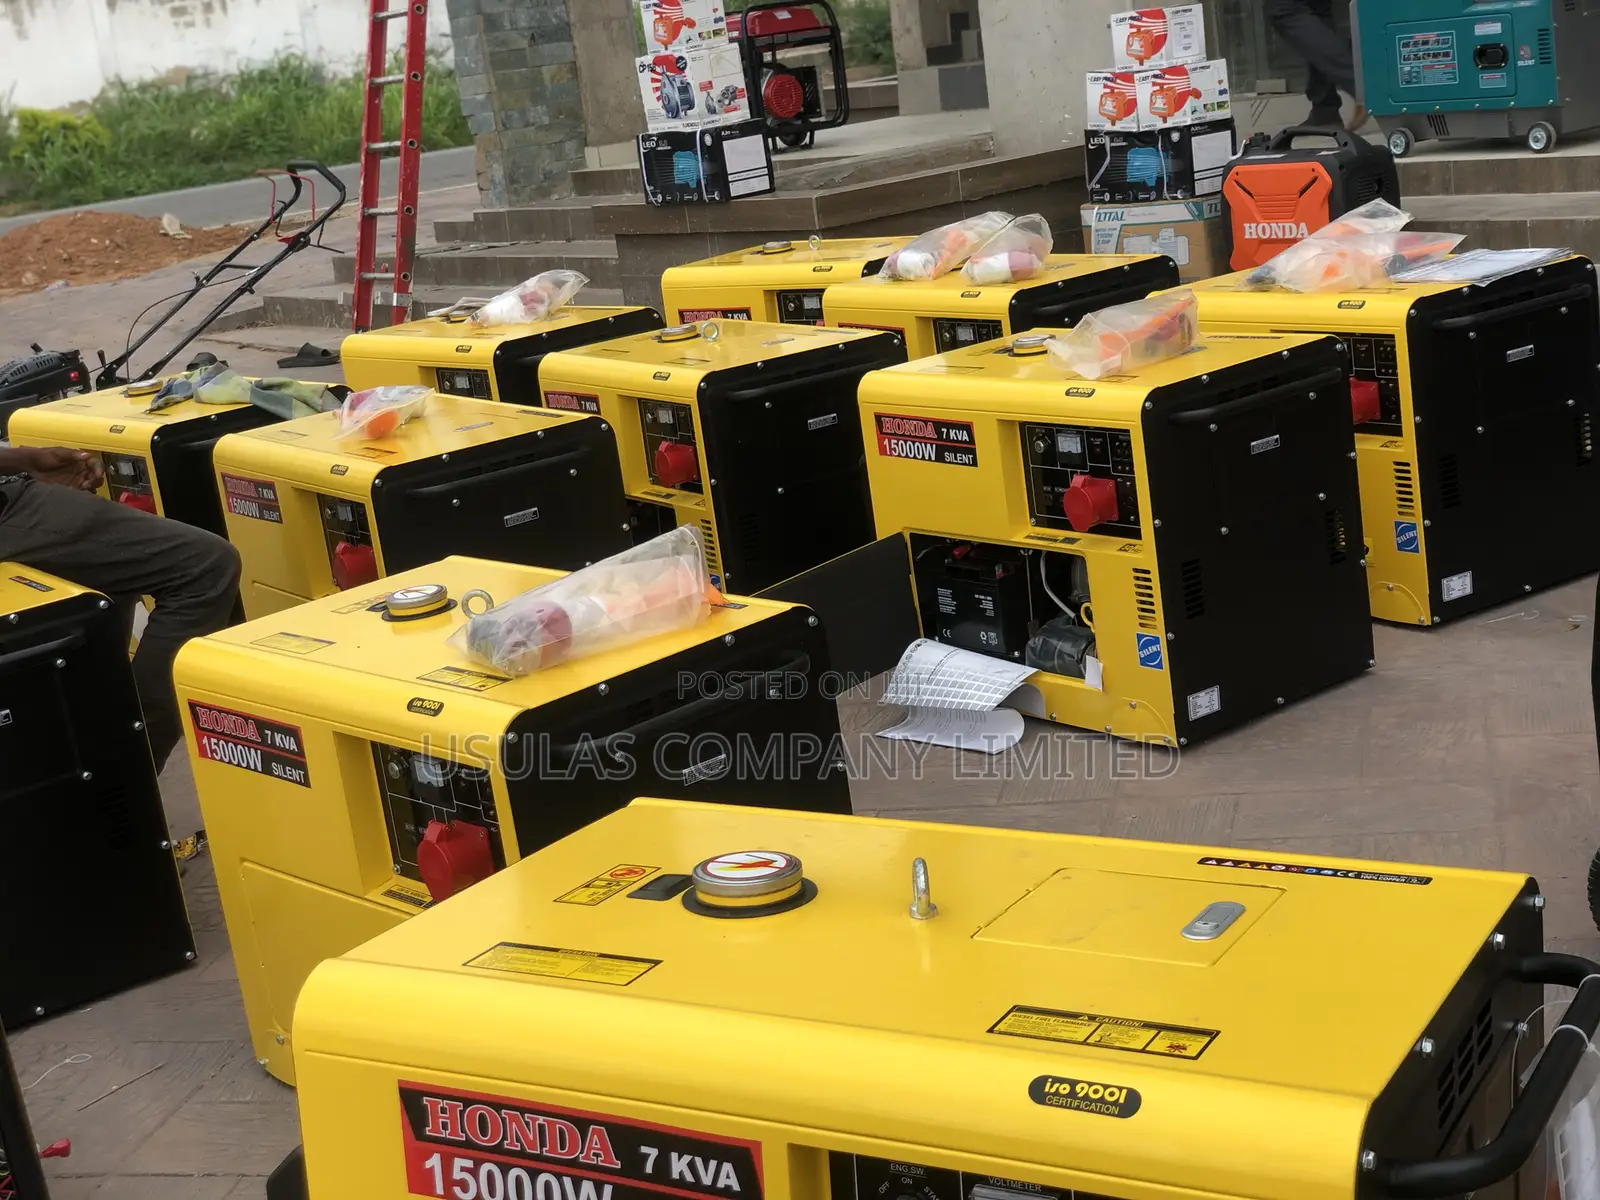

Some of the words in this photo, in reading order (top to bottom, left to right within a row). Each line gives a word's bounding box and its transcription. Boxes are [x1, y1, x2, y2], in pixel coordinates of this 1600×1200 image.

[1243, 222, 1310, 240] HONDA
[548, 394, 580, 410] HONDA
[586, 401, 598, 412] KVA
[882, 417, 937, 438] HONDA
[941, 427, 948, 440] 7
[949, 428, 969, 442] KVA
[883, 438, 936, 461] 15000W
[944, 452, 974, 465] SILENT
[229, 497, 260, 518] 15000W
[263, 510, 280, 521] SILENT
[1396, 530, 1418, 544] SILENT
[1139, 643, 1162, 658] SILENT
[196, 706, 261, 742] HONDA
[265, 730, 273, 745] 7
[274, 732, 298, 753] KVA
[202, 735, 263, 772] 15000W
[272, 762, 305, 784] SILENT
[1053, 1018, 1093, 1027] FLAMMABLE
[1095, 1016, 1144, 1028] CAUTION!
[1044, 1078, 1071, 1095] iso
[1075, 1082, 1128, 1104] 9001
[1045, 1095, 1120, 1115] CERTIFICATION
[423, 1096, 621, 1168] HONDA
[640, 1145, 659, 1174] 7
[670, 1153, 741, 1191] KVA
[878, 1180, 891, 1195] OFF
[901, 1177, 913, 1185] ON
[988, 1176, 1042, 1193] VOLTMETER
